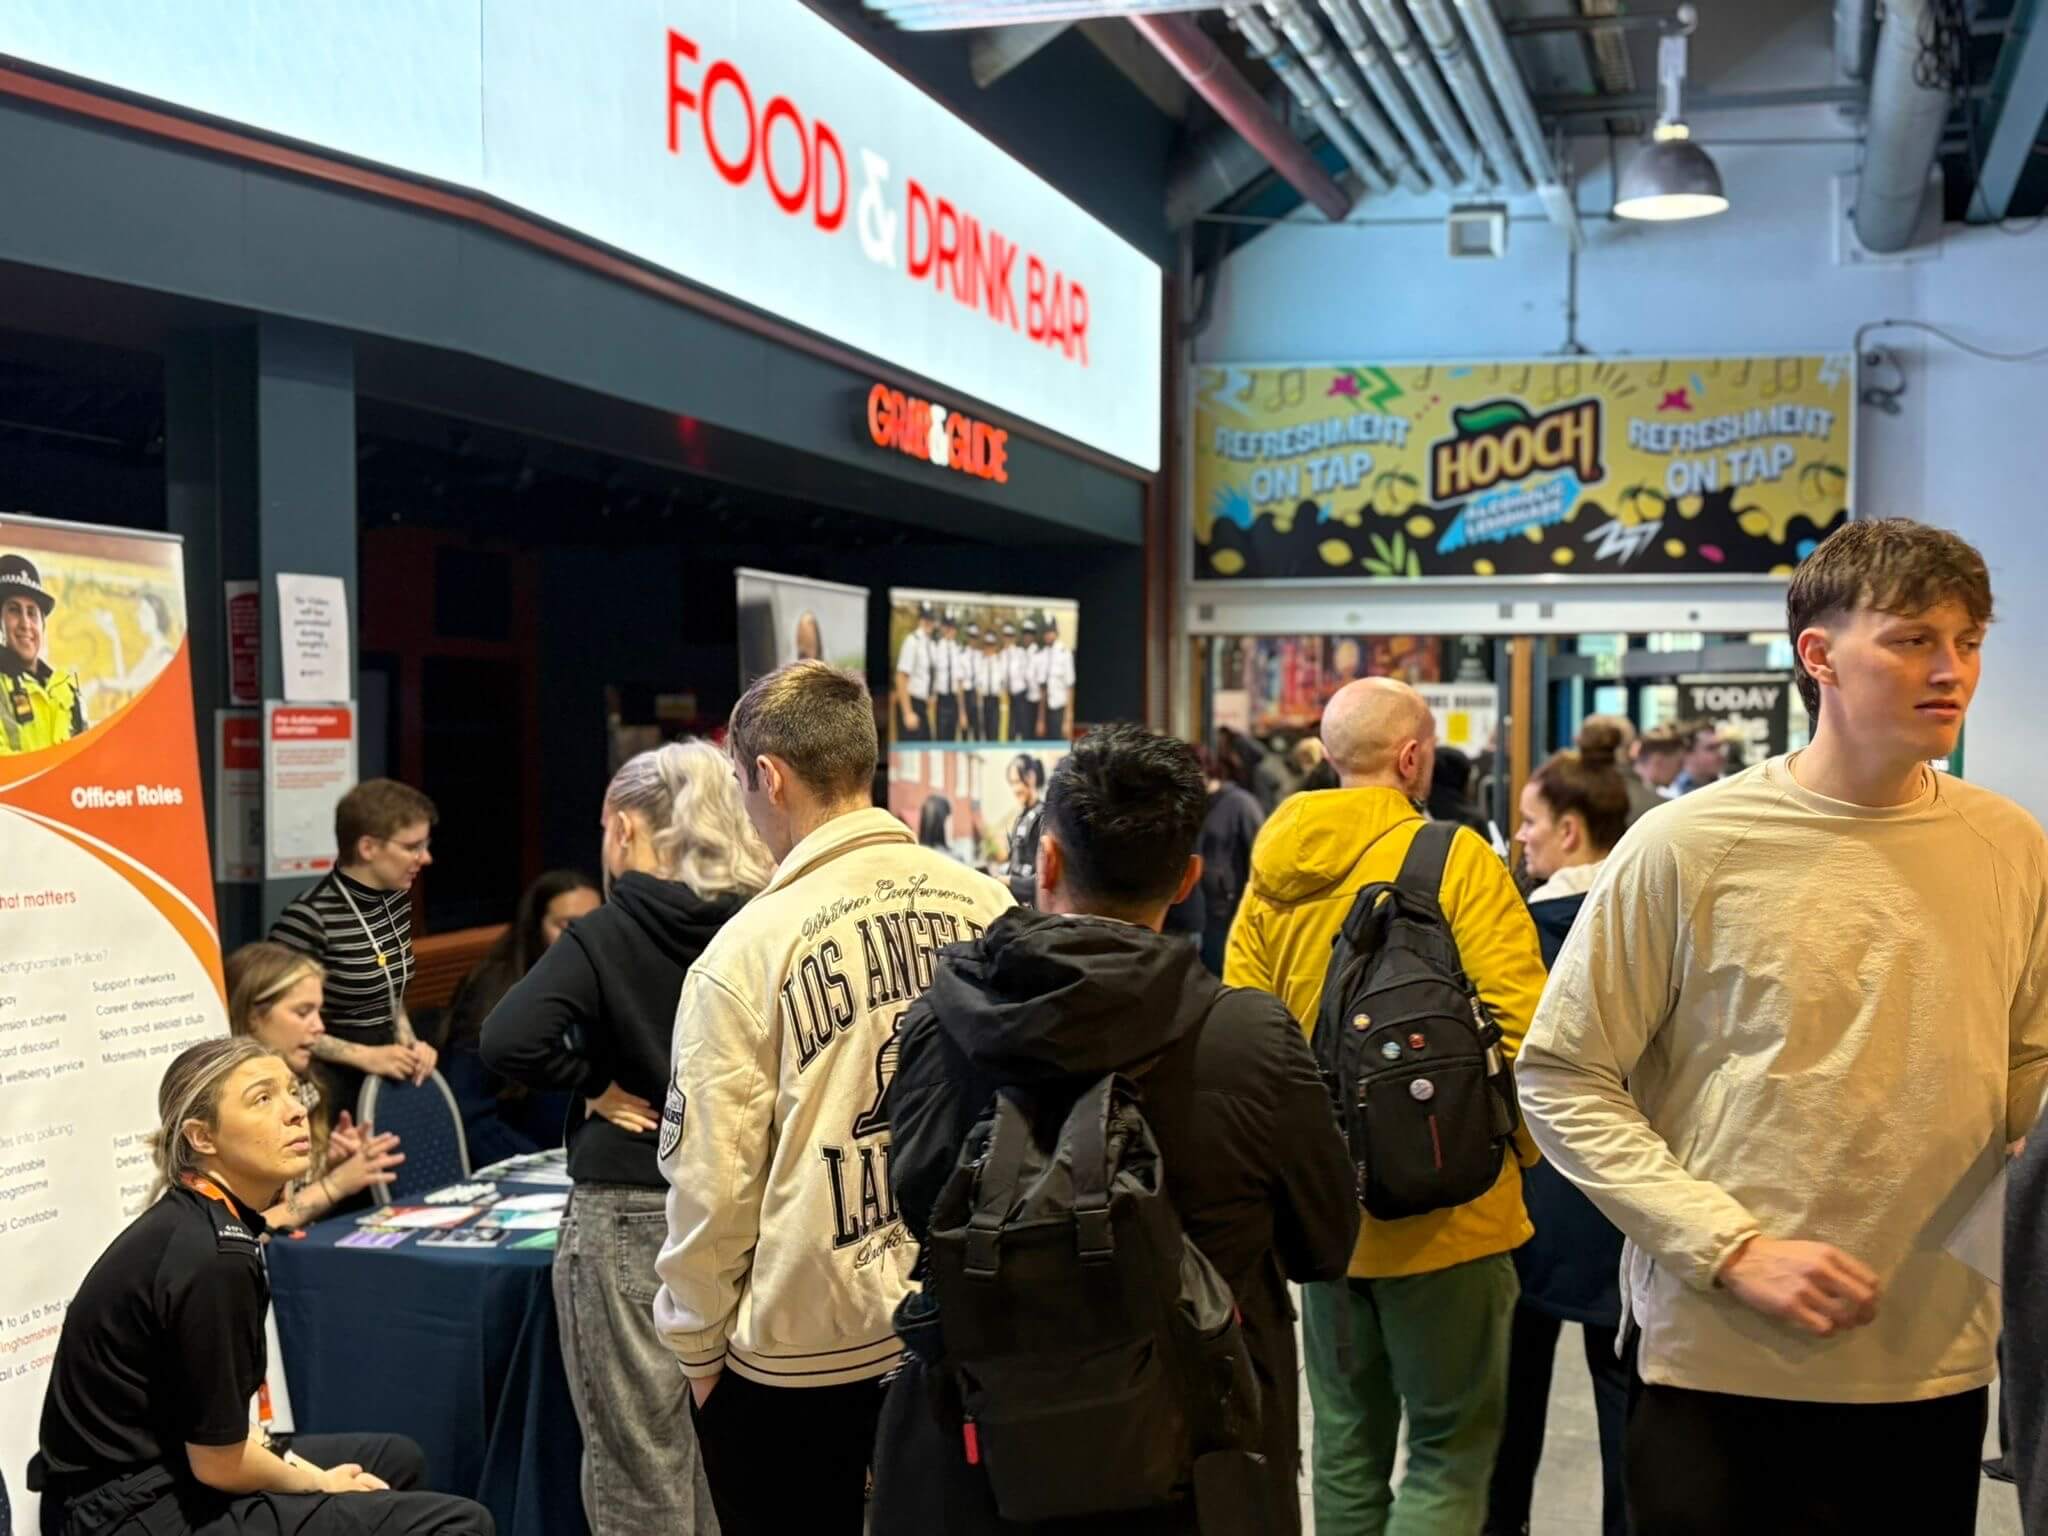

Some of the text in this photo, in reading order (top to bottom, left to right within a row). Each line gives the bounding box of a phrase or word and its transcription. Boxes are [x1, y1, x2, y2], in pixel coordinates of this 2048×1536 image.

[667, 27, 1090, 369] FOOD & DRINK BAR
[1214, 412, 1411, 462] REFRESHMENT
[1628, 403, 1836, 454] REFRESHMENT
[1434, 402, 1599, 498] HOOCH
[1251, 451, 1373, 502] ON TAP
[1666, 443, 1795, 498] ON TAP
[1689, 685, 1780, 712] TODAY
[71, 784, 183, 810] Officer Roles
[24, 888, 77, 908] matters
[92, 972, 177, 993] Support networks
[96, 991, 195, 1016] Career development
[780, 935, 858, 1075] LOS
[31, 1012, 67, 1028] scheme
[98, 1014, 205, 1041] Sports and social club
[20, 1036, 60, 1056] discount
[101, 1047, 147, 1064] Maternity
[149, 1043, 169, 1056] and
[6, 1066, 51, 1083] wellbeing
[53, 1060, 84, 1075] service
[10, 1207, 59, 1230] Constable
[7, 1316, 17, 1329] to
[20, 1312, 30, 1325] us
[32, 1308, 41, 1320] to
[44, 1299, 62, 1317] find
